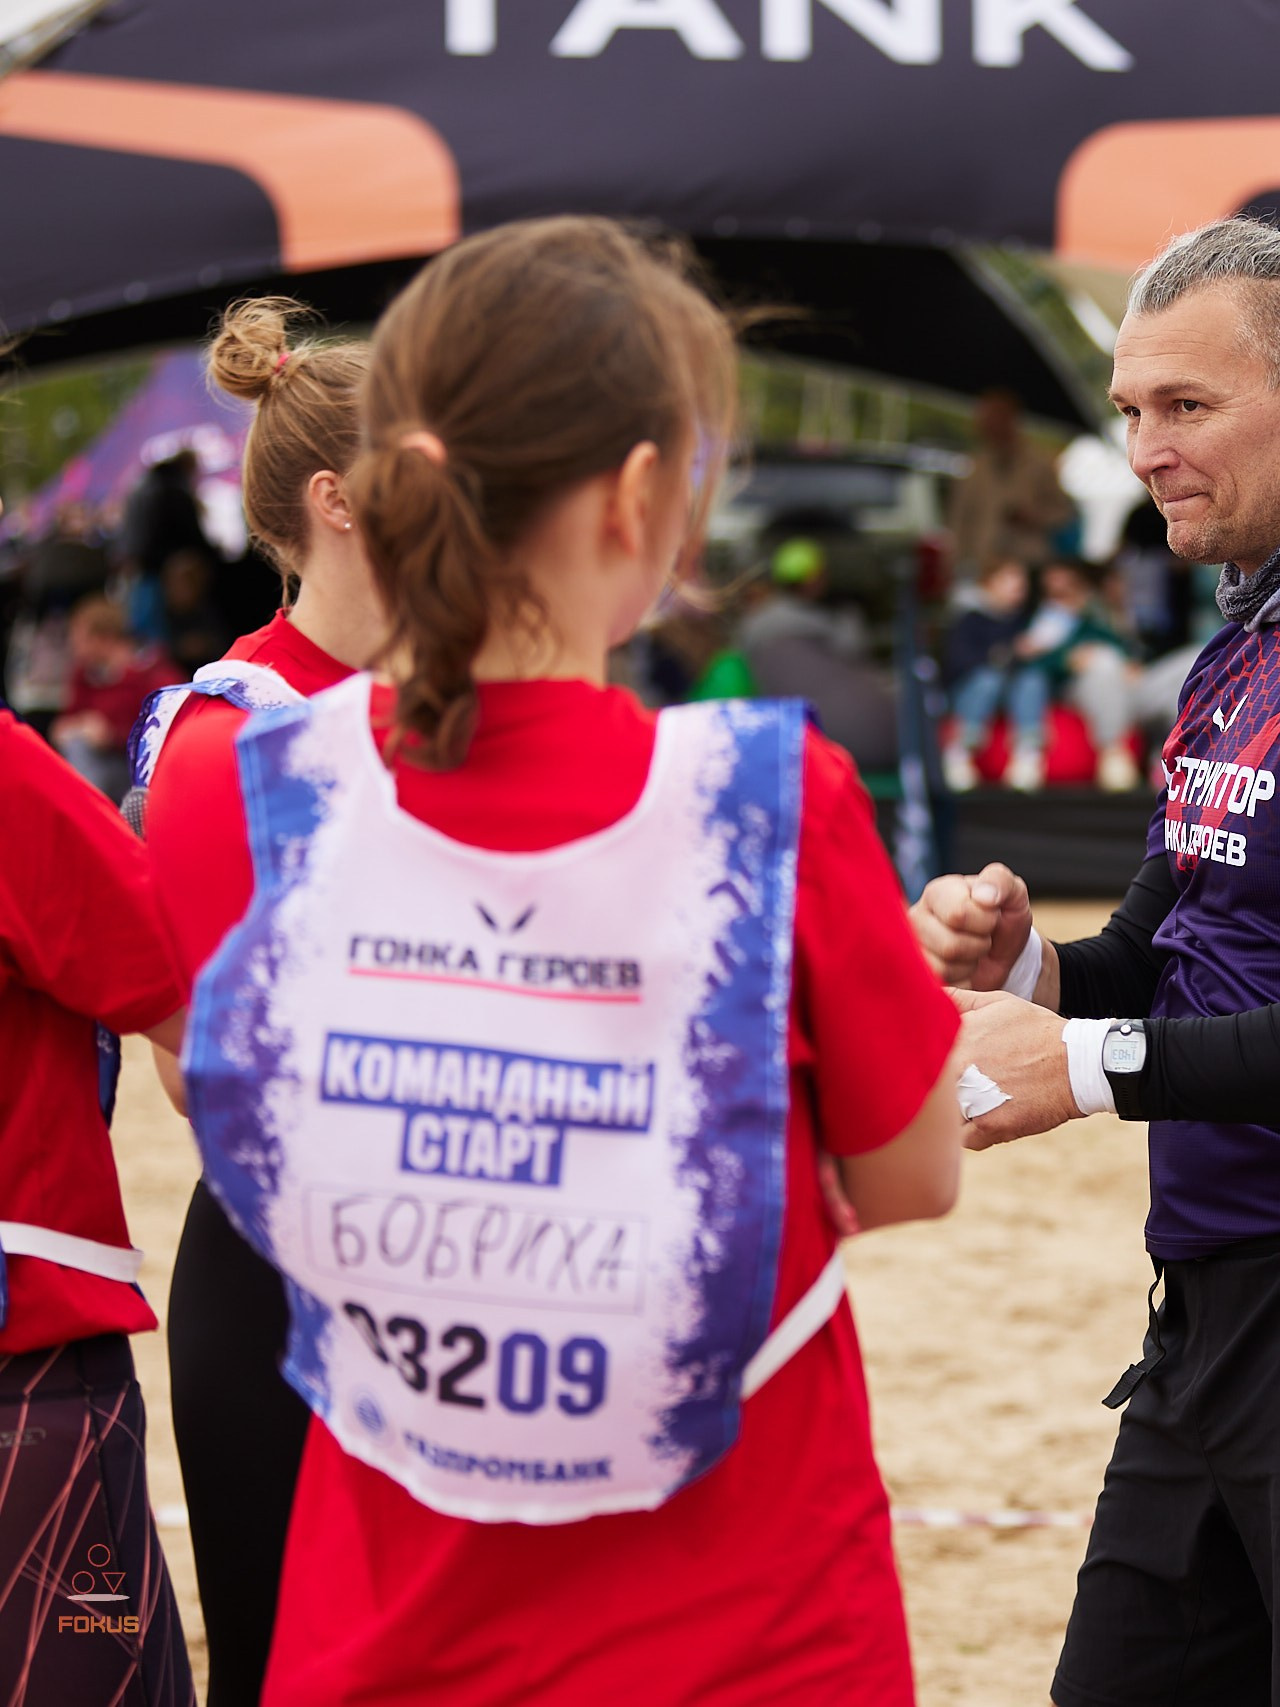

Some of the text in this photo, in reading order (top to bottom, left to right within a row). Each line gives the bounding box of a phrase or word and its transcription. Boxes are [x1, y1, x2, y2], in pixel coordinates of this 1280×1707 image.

[1162, 756, 1275, 817] СТРУКТОР
[350, 935, 642, 989] ГОНКА ГЕРОЕВ
[326, 1036, 651, 1128] КОМАНДНЫЙ
[405, 1112, 560, 1184] СТАРТ
[331, 1194, 630, 1292] БОБРИХА
